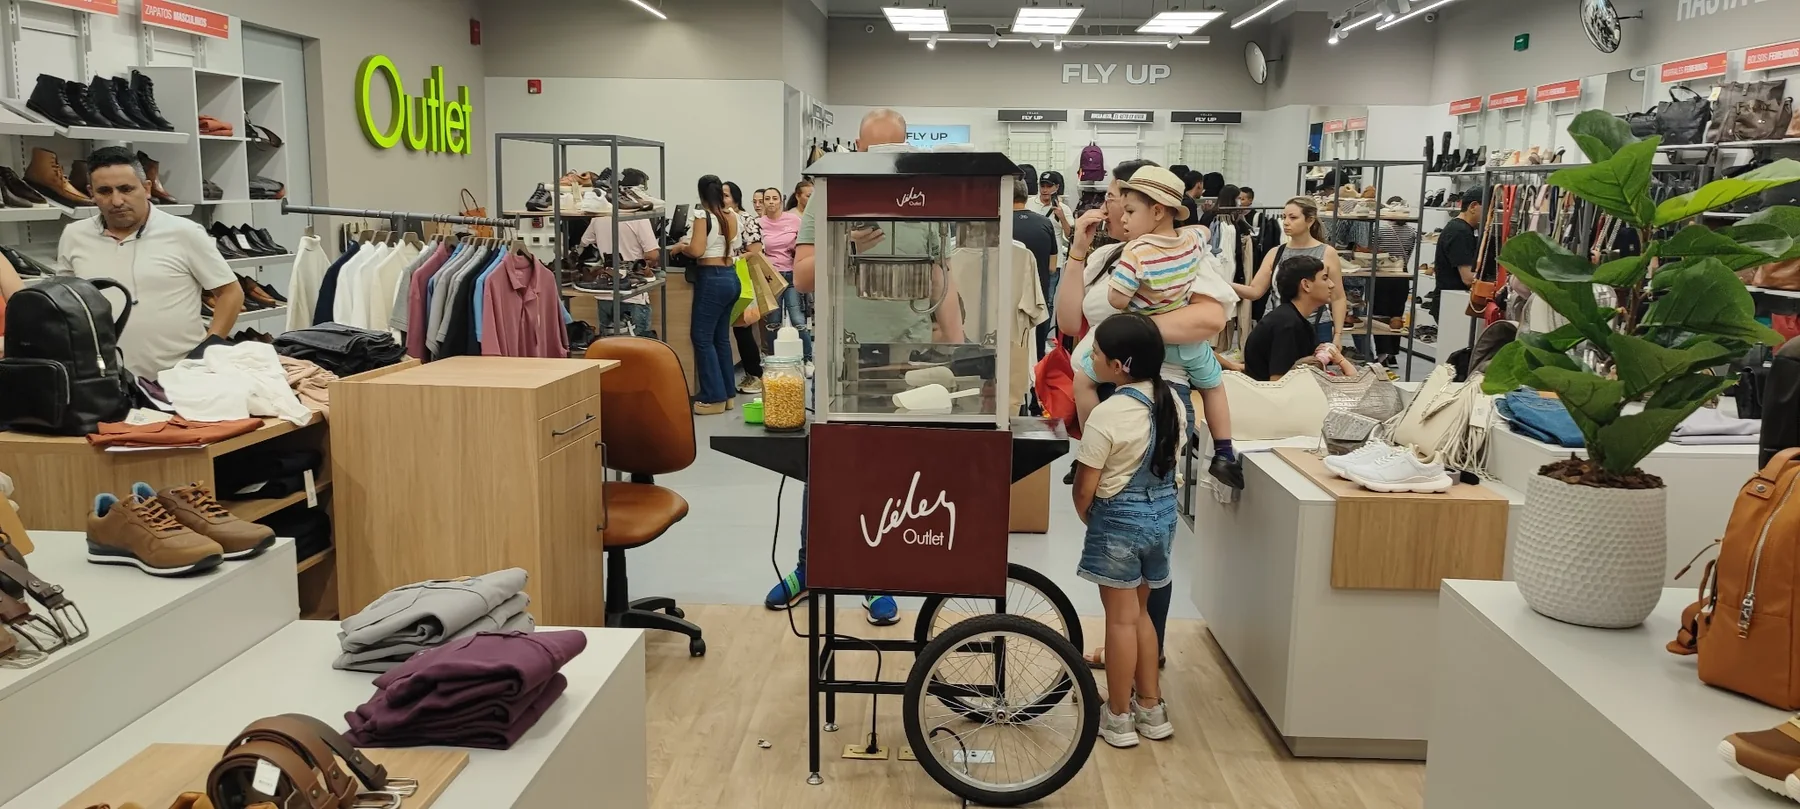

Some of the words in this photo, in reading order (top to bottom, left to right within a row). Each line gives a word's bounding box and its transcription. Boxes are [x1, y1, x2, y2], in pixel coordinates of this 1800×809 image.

[144, 4, 172, 20] ZAPATOS
[1747, 53, 1768, 65] BOLSOS
[1062, 63, 1118, 84] FLY
[1125, 64, 1172, 84] UP
[355, 54, 472, 155] Outlet
[906, 132, 926, 141] FLY
[930, 132, 948, 141] UP
[903, 528, 945, 546] Outlet
